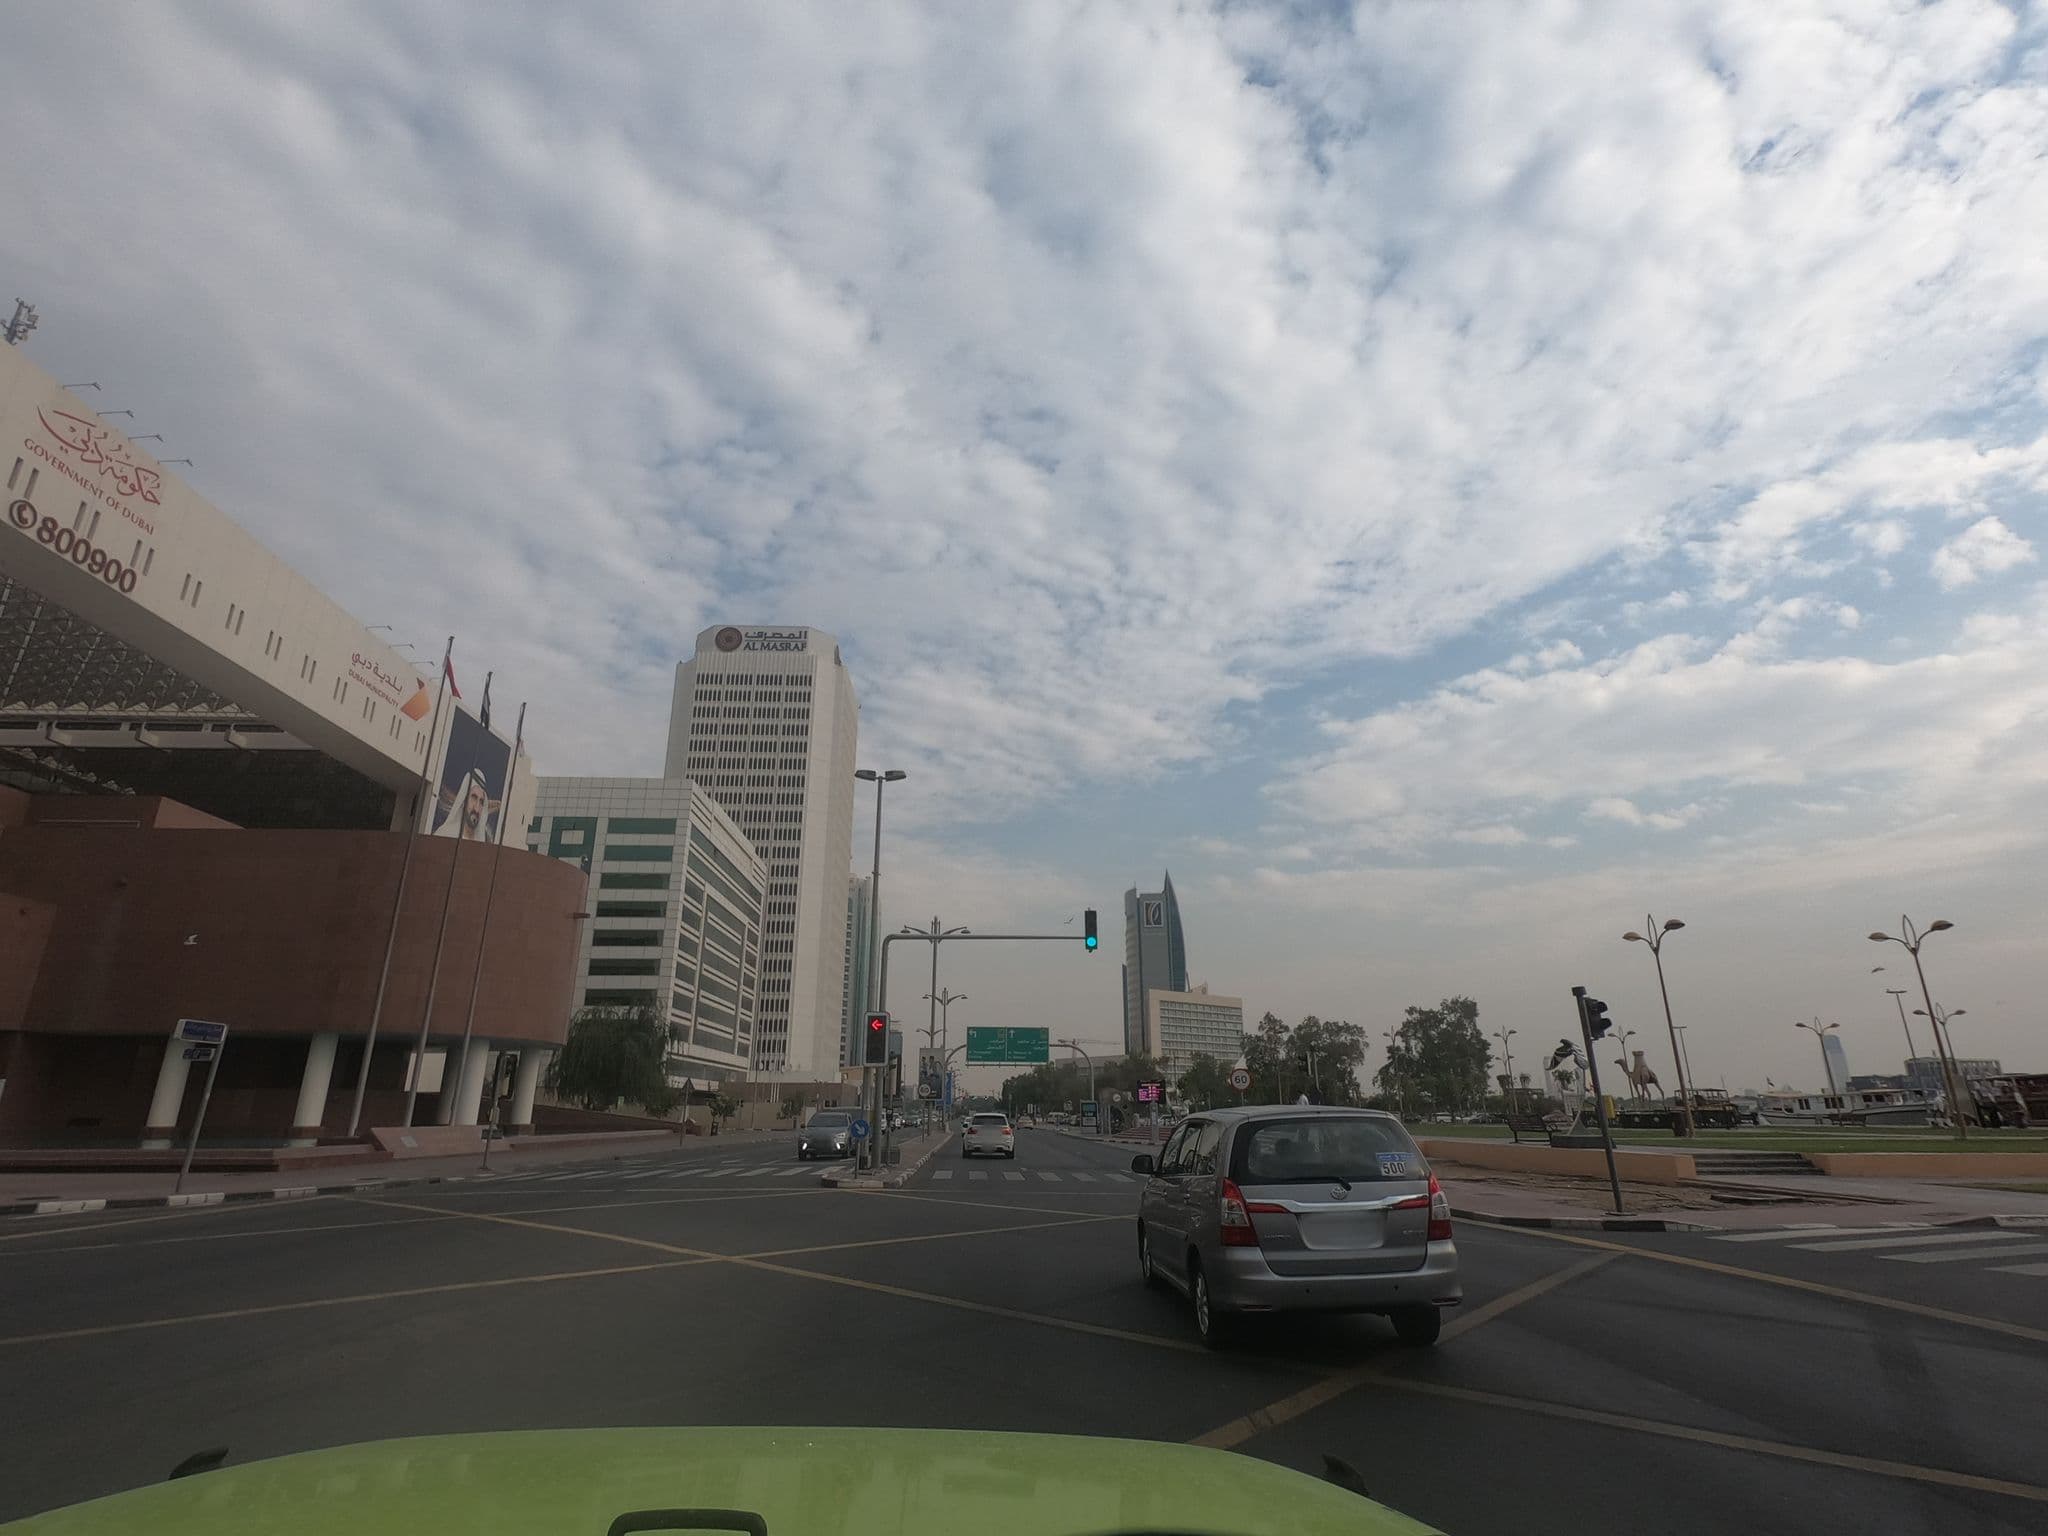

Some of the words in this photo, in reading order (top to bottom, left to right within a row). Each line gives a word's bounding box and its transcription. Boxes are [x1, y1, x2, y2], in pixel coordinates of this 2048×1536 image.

[24, 438, 104, 500] GOVERNMENT
[105, 495, 121, 514] OF
[121, 508, 155, 536] DUBAI
[36, 516, 137, 593] 800900
[743, 642, 759, 651] AL
[760, 642, 808, 652] MASRAF
[351, 652, 372, 670] دبي
[373, 662, 403, 696] بلدية
[1234, 1075, 1248, 1084] 60
